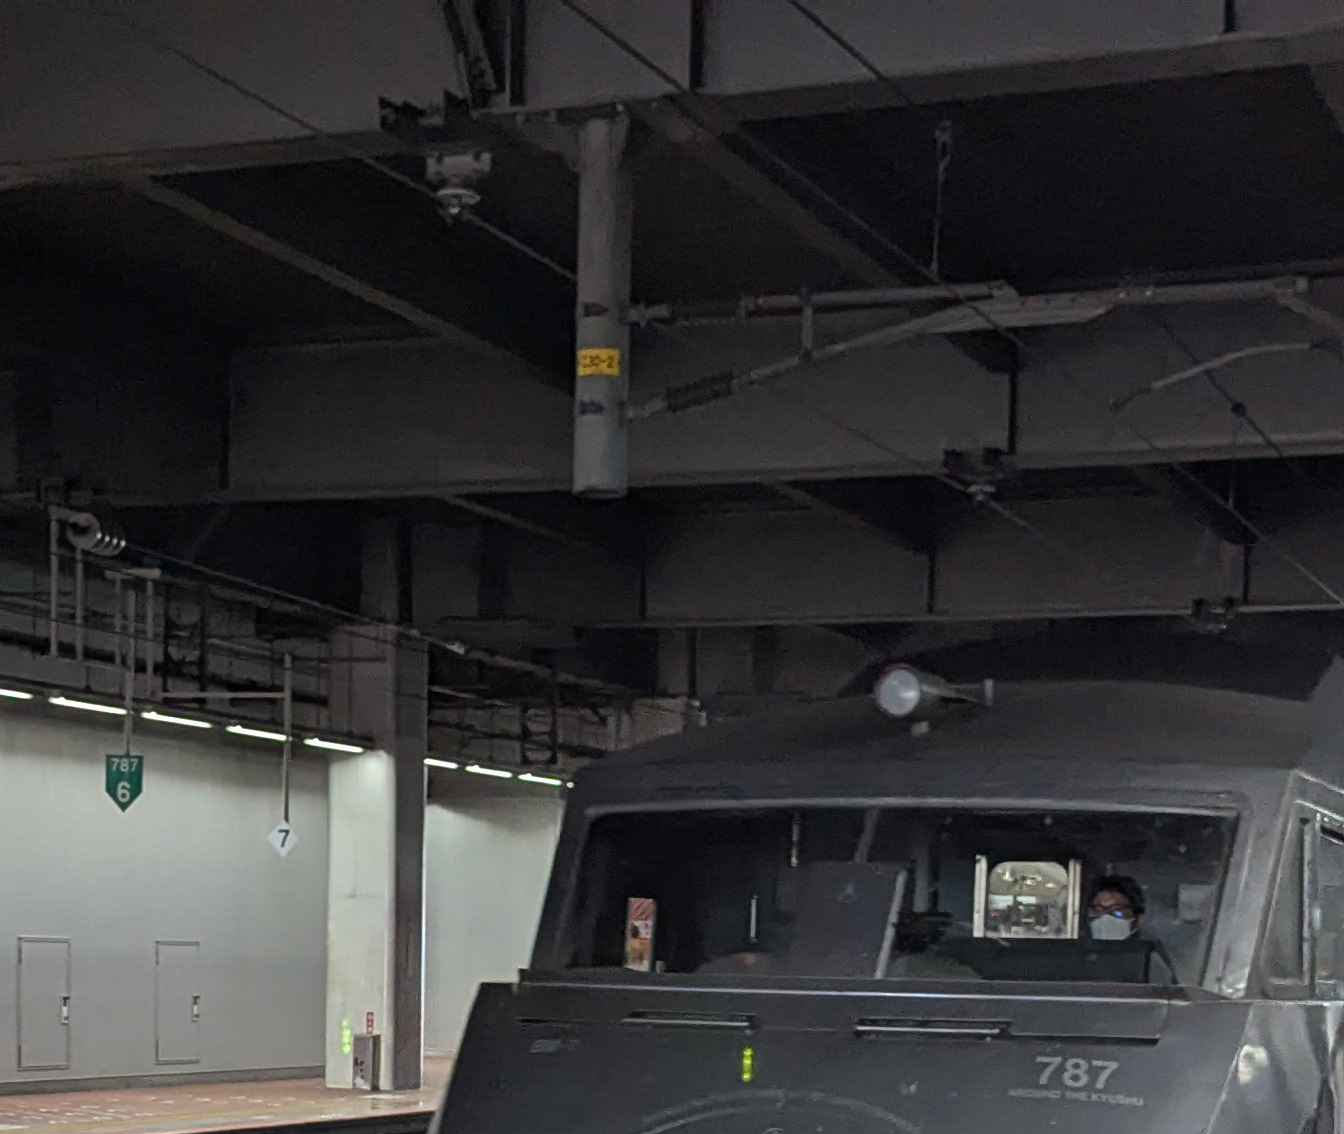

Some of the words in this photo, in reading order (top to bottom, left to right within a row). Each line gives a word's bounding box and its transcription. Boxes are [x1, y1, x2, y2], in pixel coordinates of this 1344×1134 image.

[110, 757, 139, 772] 787
[116, 781, 131, 803] 6
[277, 828, 291, 848] 7
[1034, 1055, 1120, 1090] 787
